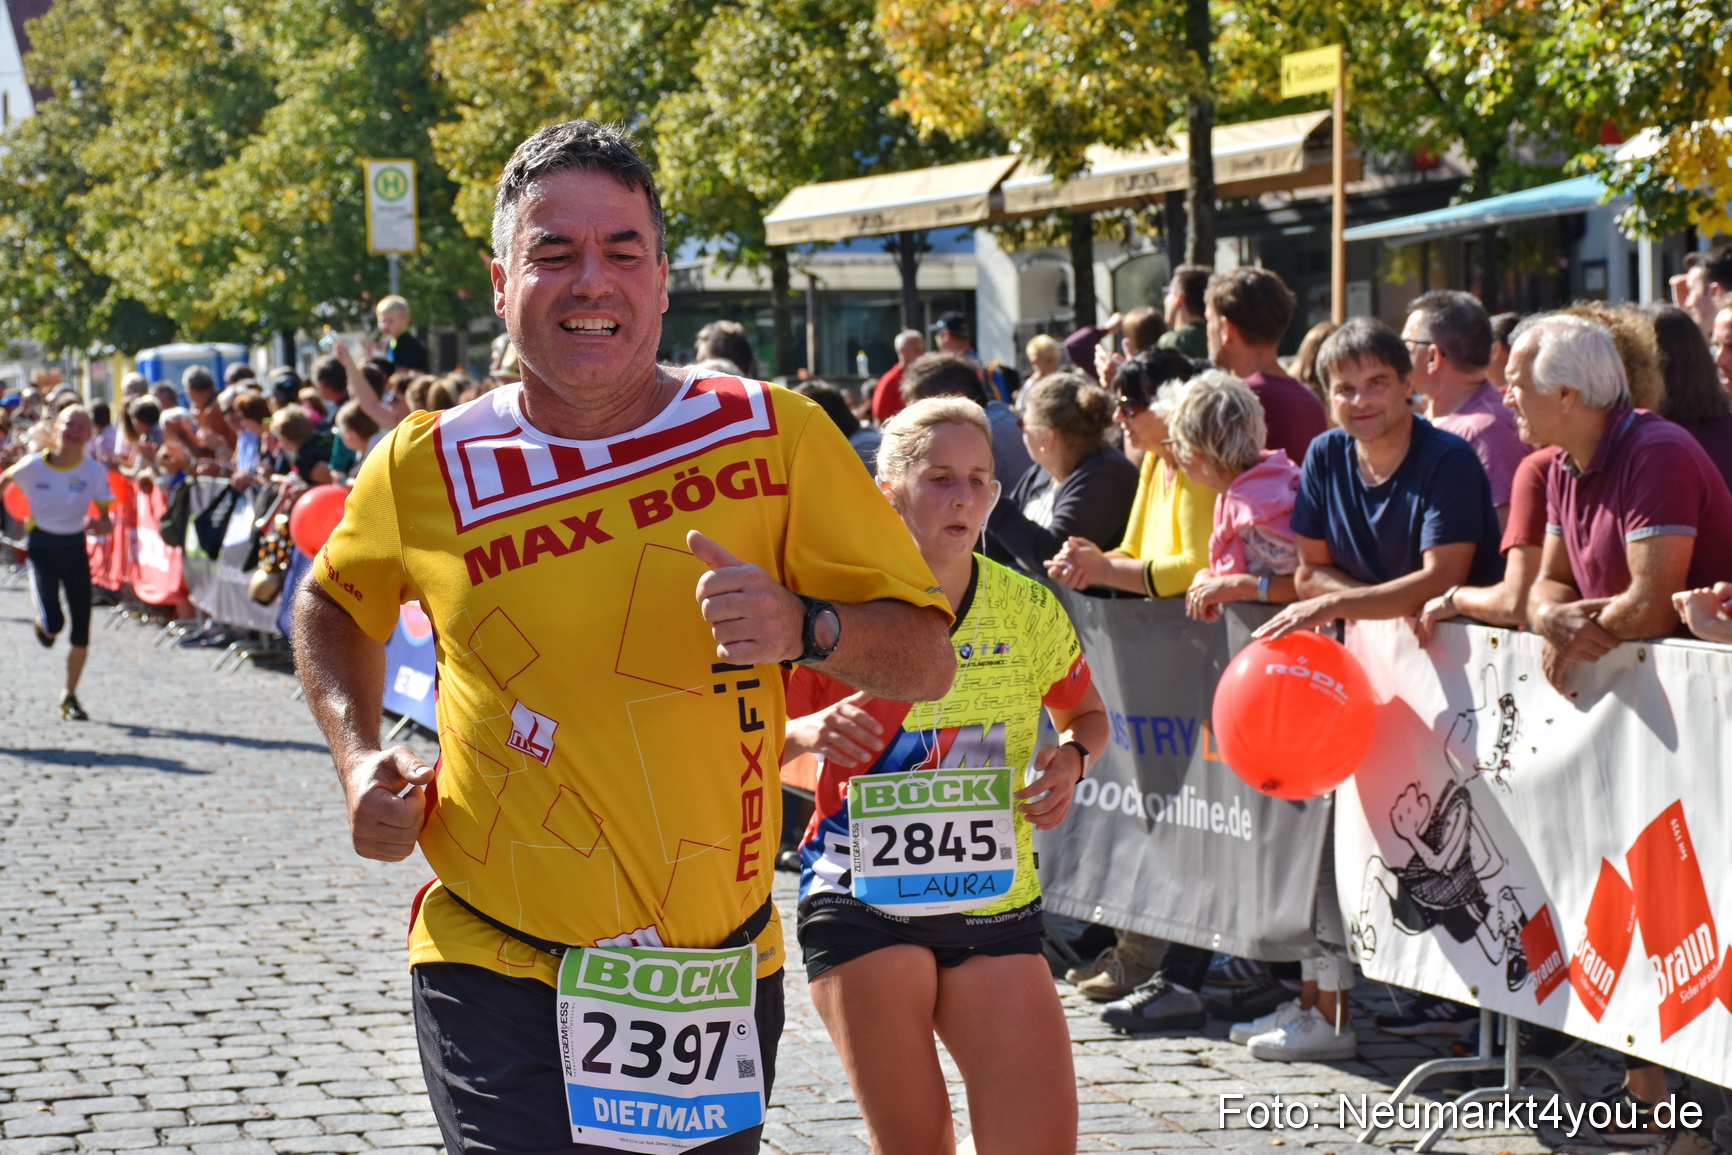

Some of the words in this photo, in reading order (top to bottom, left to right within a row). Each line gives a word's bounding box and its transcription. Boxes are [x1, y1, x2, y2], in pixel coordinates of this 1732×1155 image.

[463, 508, 614, 587] MAX
[628, 457, 788, 529] BÖGL
[1265, 655, 1349, 700] RÖDL
[861, 774, 1000, 813] BOCK
[871, 820, 997, 867] 2845
[897, 873, 996, 898] LAURA
[577, 953, 740, 1003] BOCK
[1573, 923, 1616, 997] Braun
[1646, 922, 1716, 1006] Braun
[582, 1011, 731, 1085] 2397
[736, 1023, 747, 1036] C
[593, 1096, 728, 1132] DIETMAR
